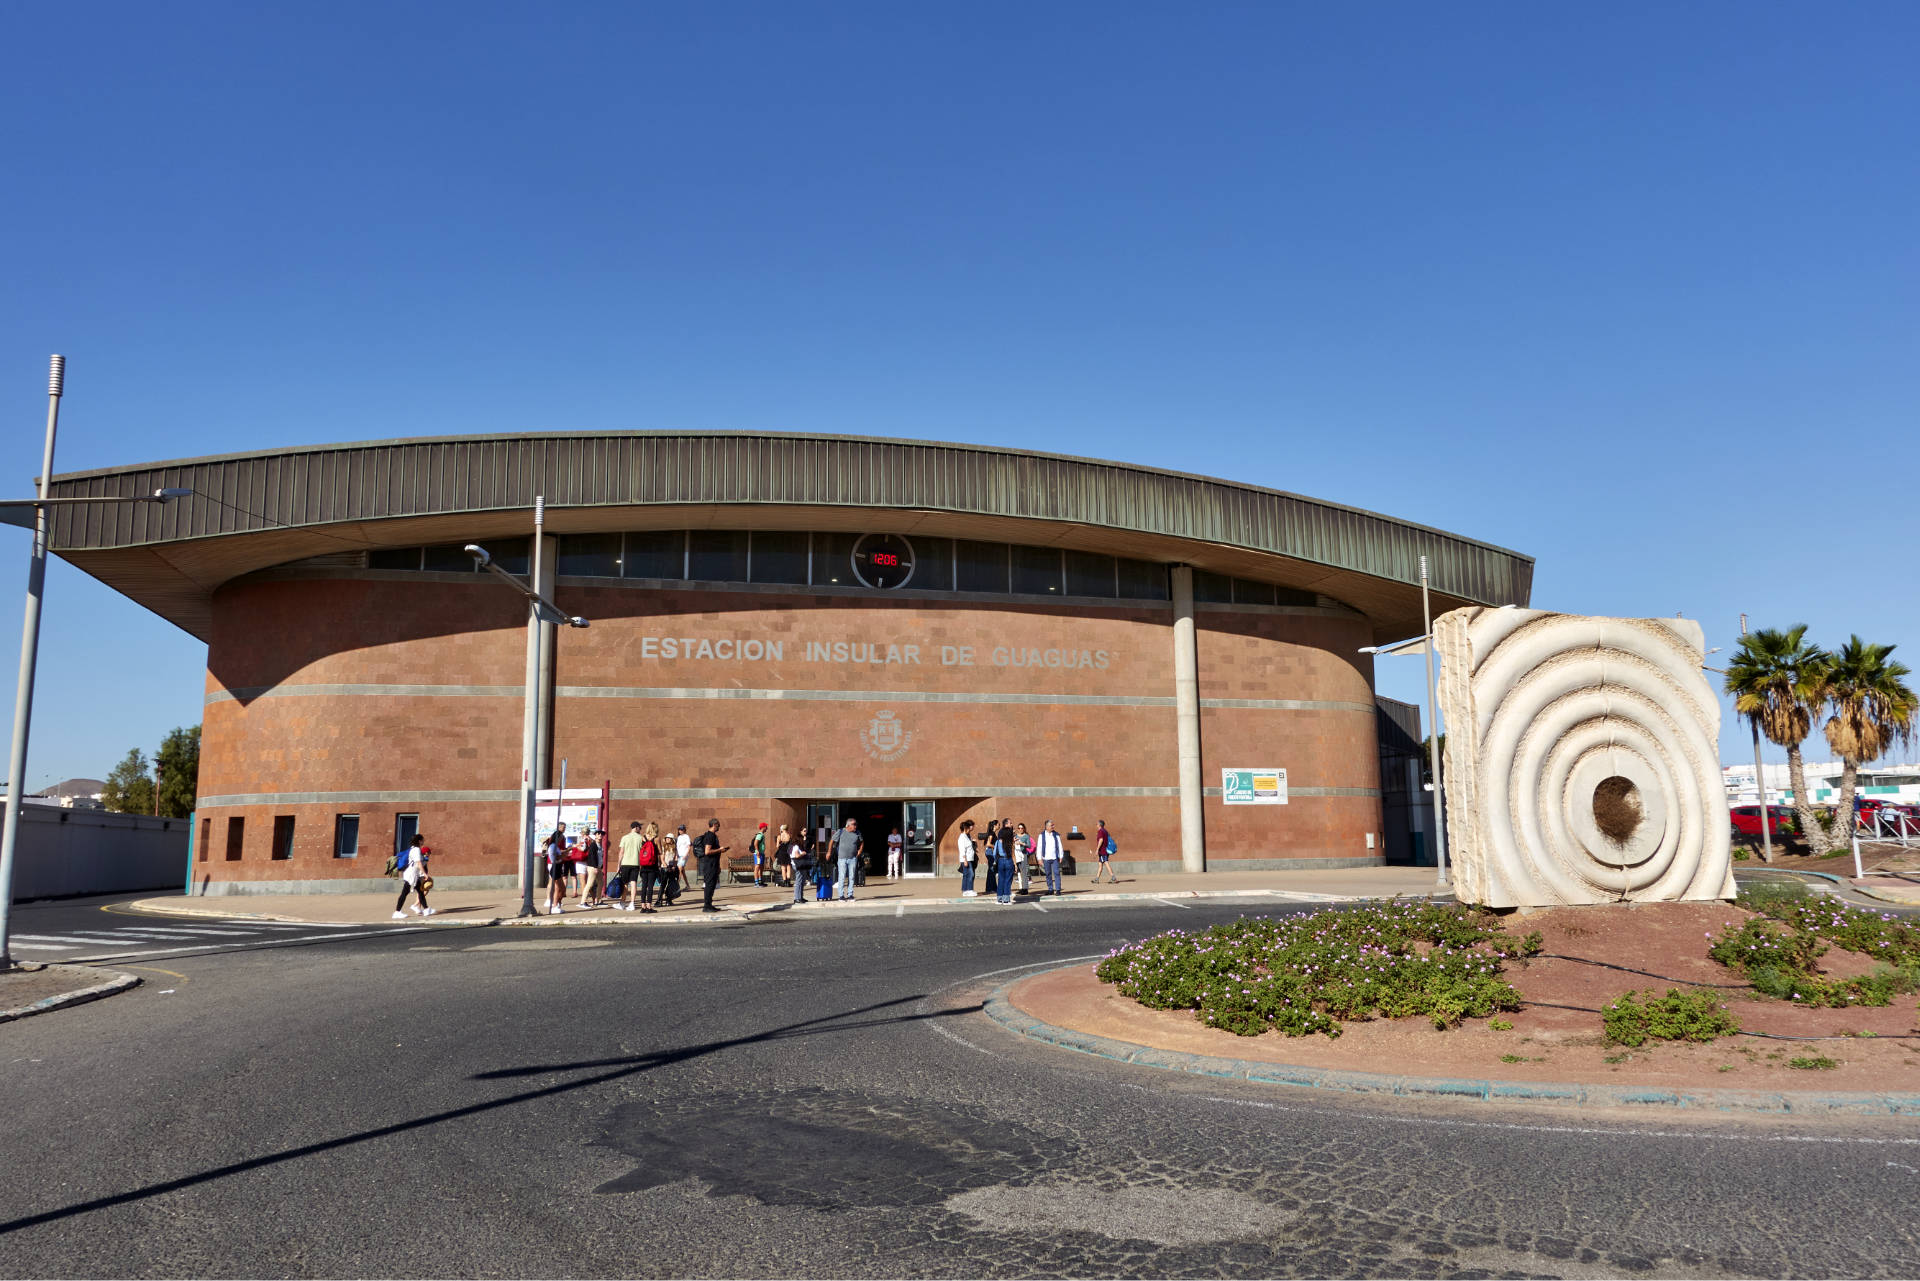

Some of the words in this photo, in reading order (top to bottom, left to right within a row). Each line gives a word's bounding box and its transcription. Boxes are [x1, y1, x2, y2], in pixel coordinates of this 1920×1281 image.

[641, 637, 783, 661] ESTACION
[805, 641, 921, 664] INSULAR
[941, 645, 975, 666] DE
[992, 647, 1110, 669] GUAGUAS
